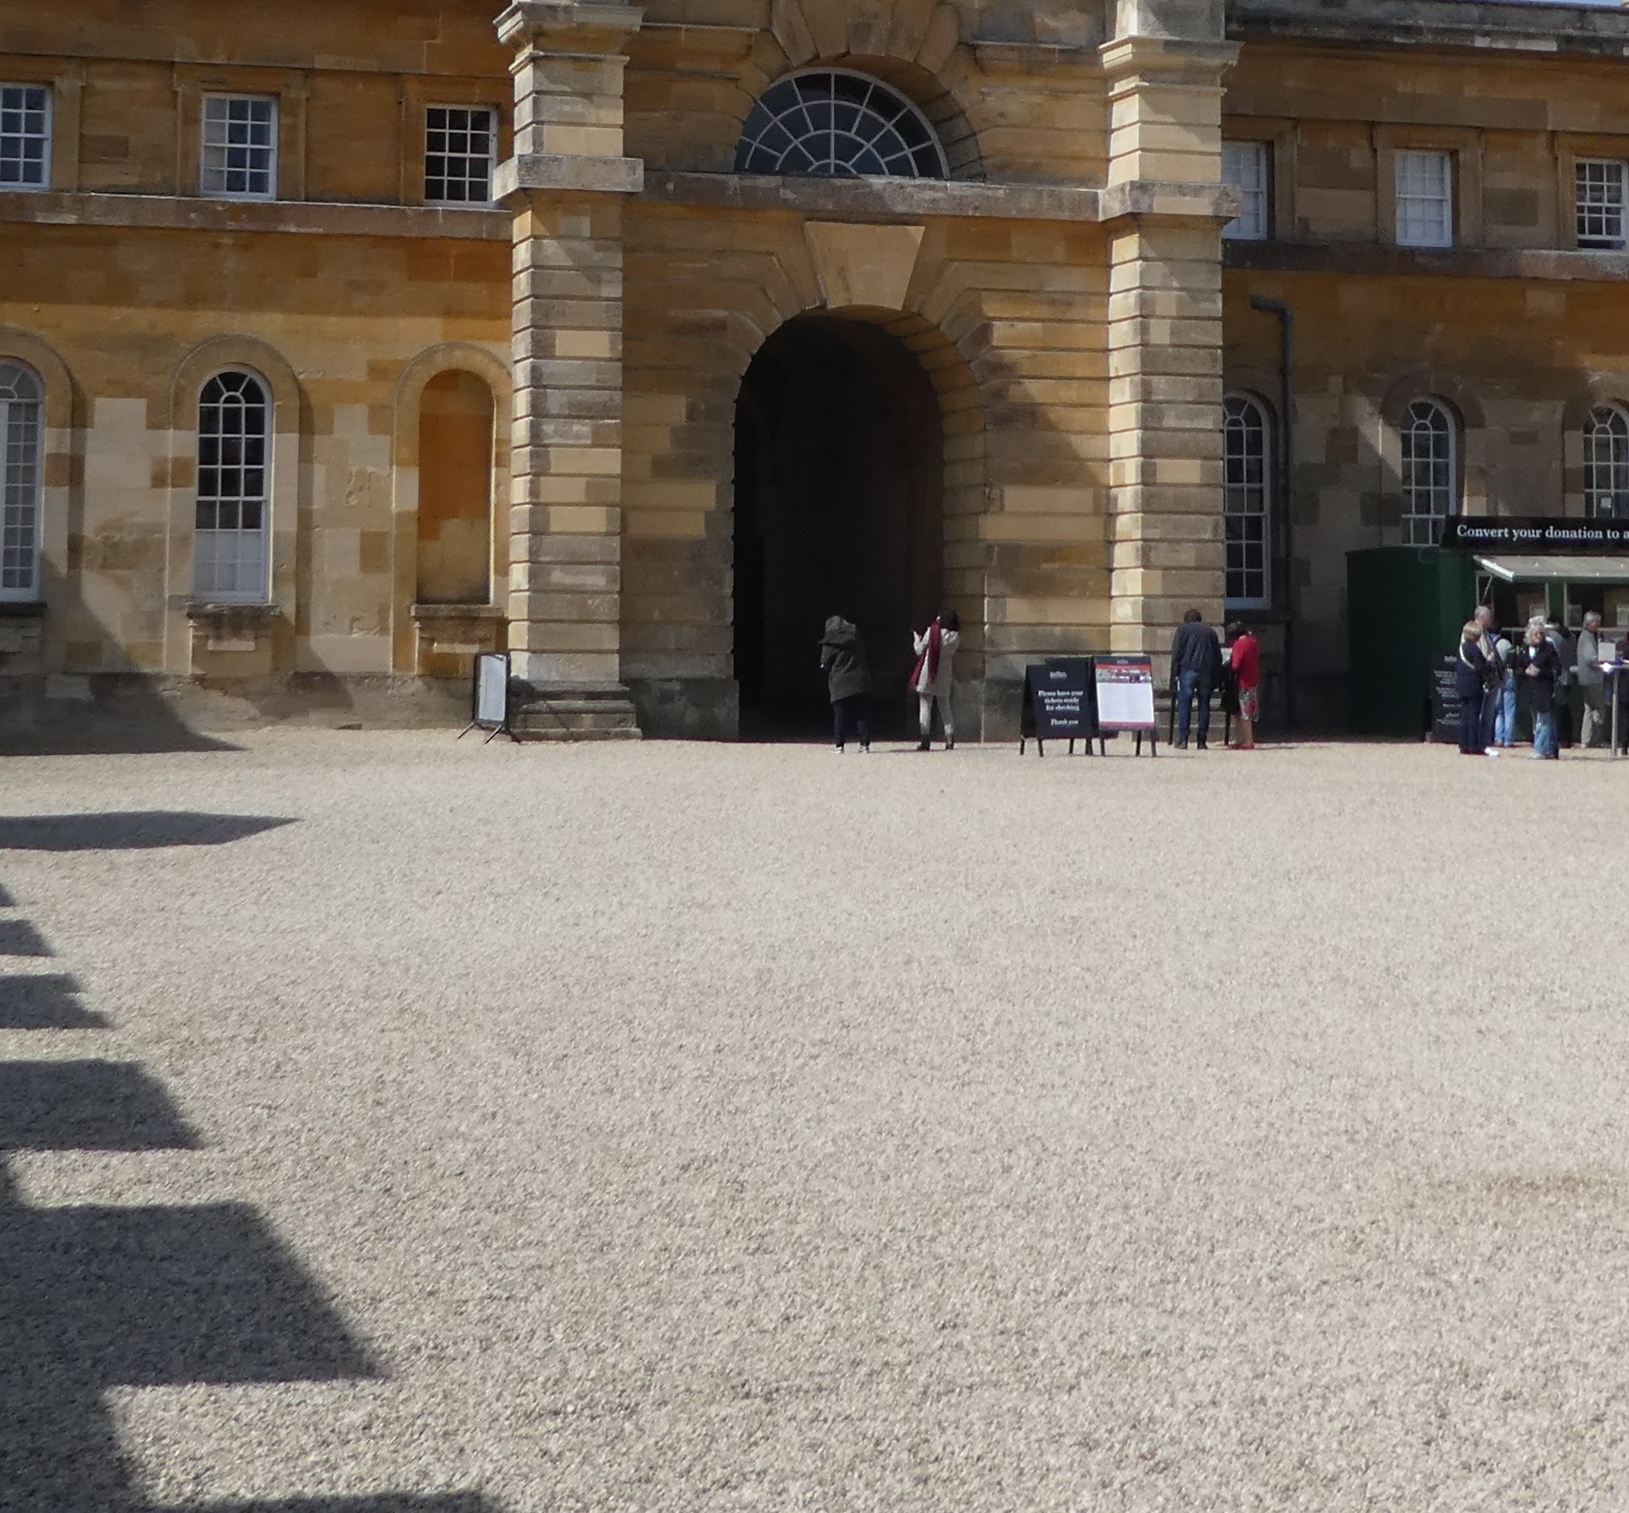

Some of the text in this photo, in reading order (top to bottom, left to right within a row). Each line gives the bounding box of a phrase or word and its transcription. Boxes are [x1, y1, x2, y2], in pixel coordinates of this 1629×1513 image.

[1456, 524, 1510, 538] Convert
[1512, 528, 1542, 542] your
[1545, 526, 1603, 539] donation
[1606, 528, 1620, 539] to
[1057, 689, 1070, 697] have
[1051, 718, 1068, 727] Thank
